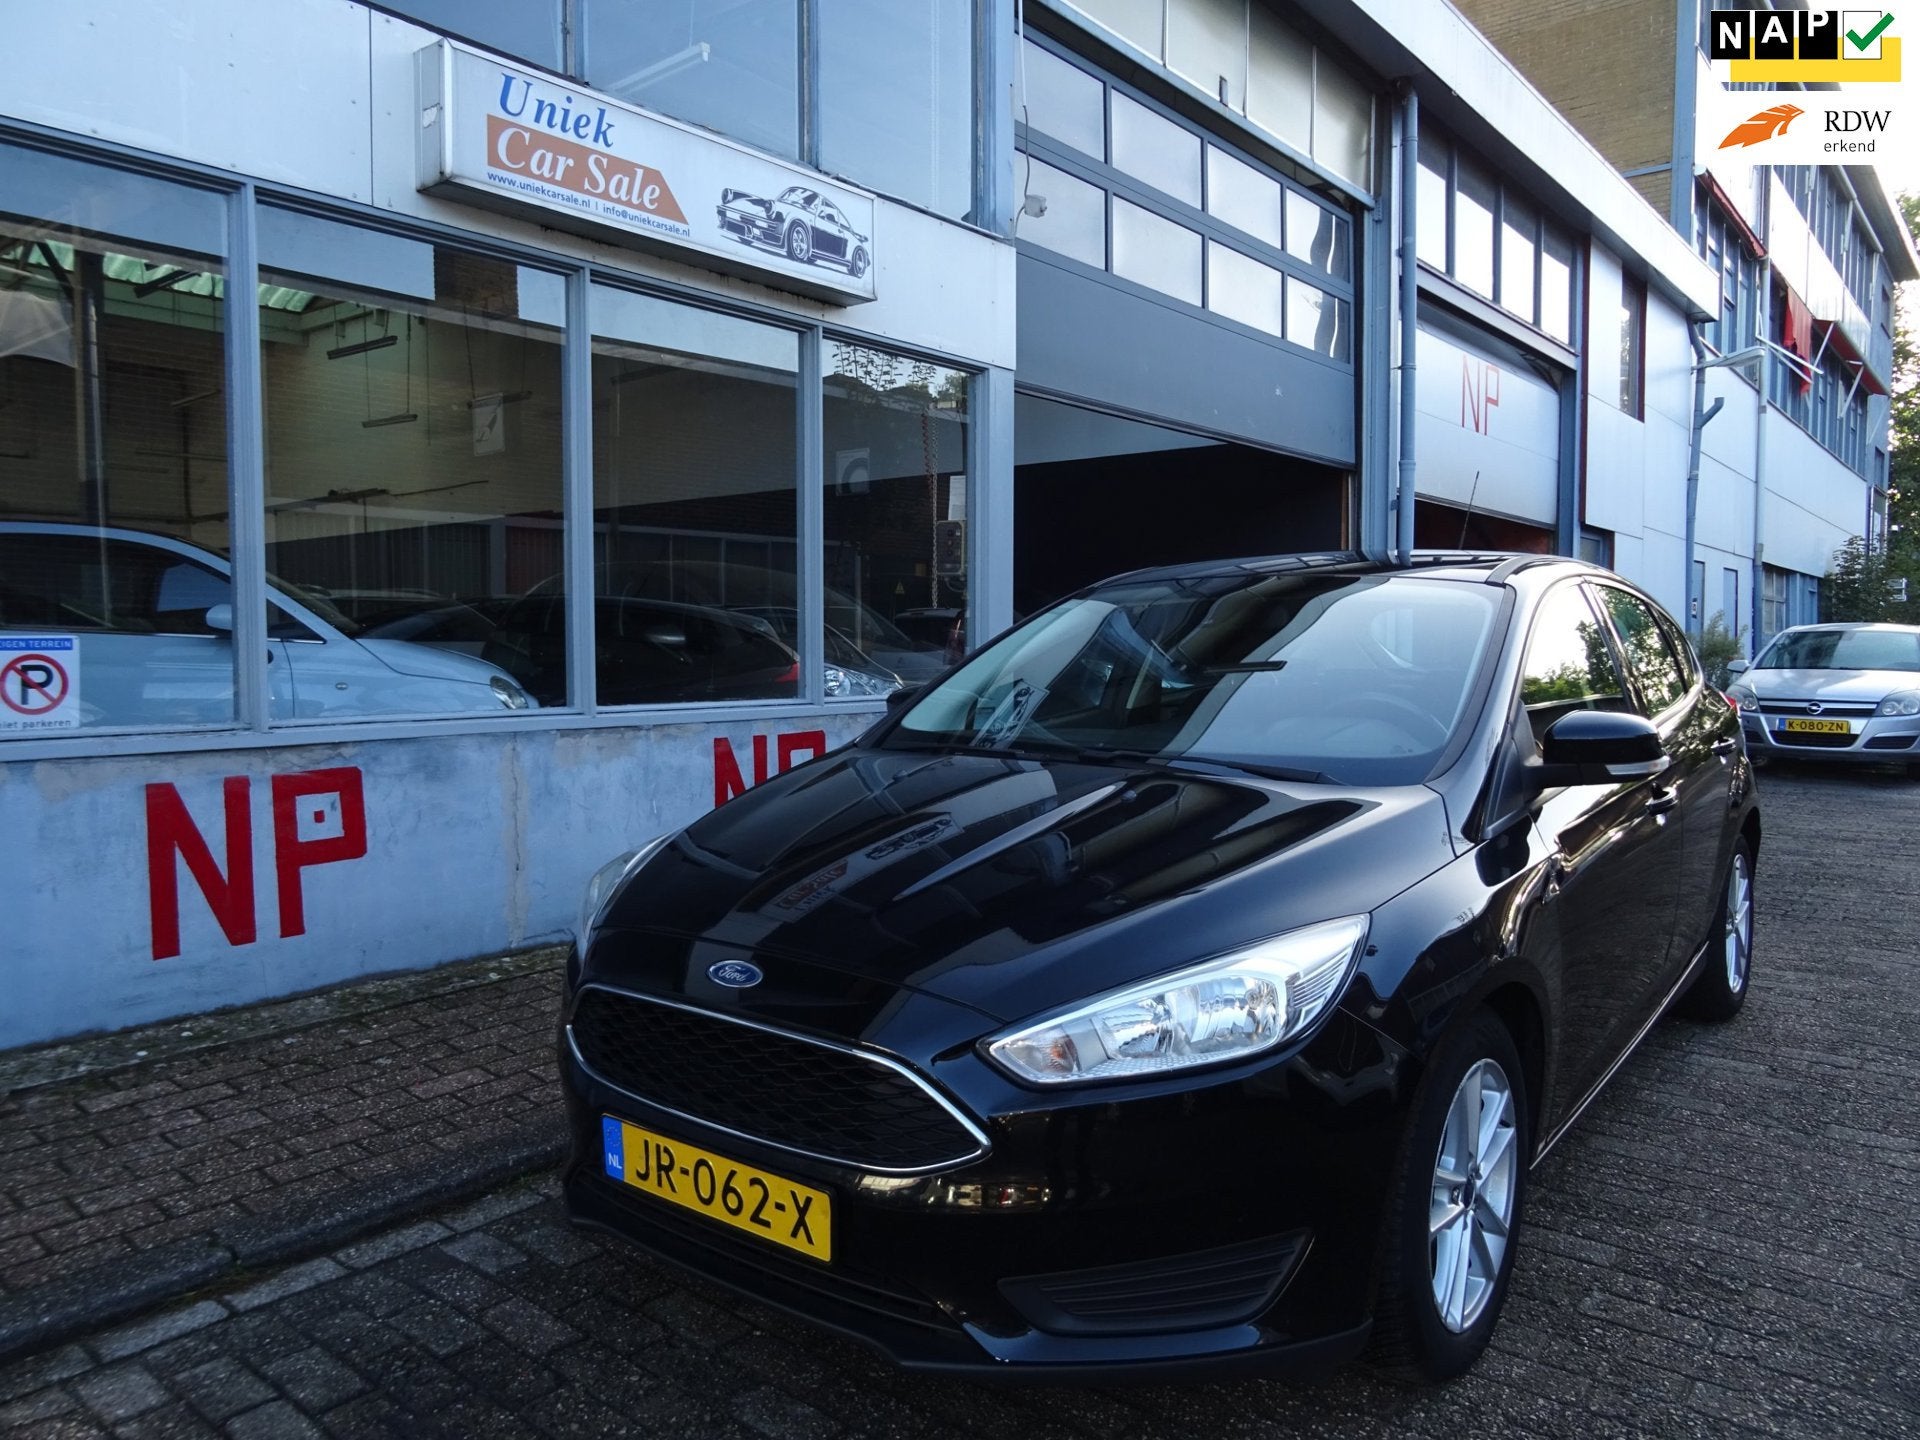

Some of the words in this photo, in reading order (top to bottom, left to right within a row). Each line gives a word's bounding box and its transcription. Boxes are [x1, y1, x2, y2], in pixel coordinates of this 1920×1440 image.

[500, 72, 615, 148] Uniek
[497, 127, 574, 181] Car
[584, 154, 660, 210] Sale
[487, 171, 591, 208] www.uniekcarsale.nl
[602, 203, 690, 238] info@uniekcarsale.nl
[1461, 353, 1499, 436] NP
[0, 640, 26, 649] IGEN
[29, 640, 71, 649] TERREIN
[0, 719, 18, 729] iet
[22, 719, 71, 730] parkeren
[1787, 720, 1844, 732] K-080-ZN
[145, 766, 368, 960] NP
[718, 964, 751, 982] Ford
[608, 1152, 622, 1170] NL
[635, 1139, 815, 1246] JR-062-X
